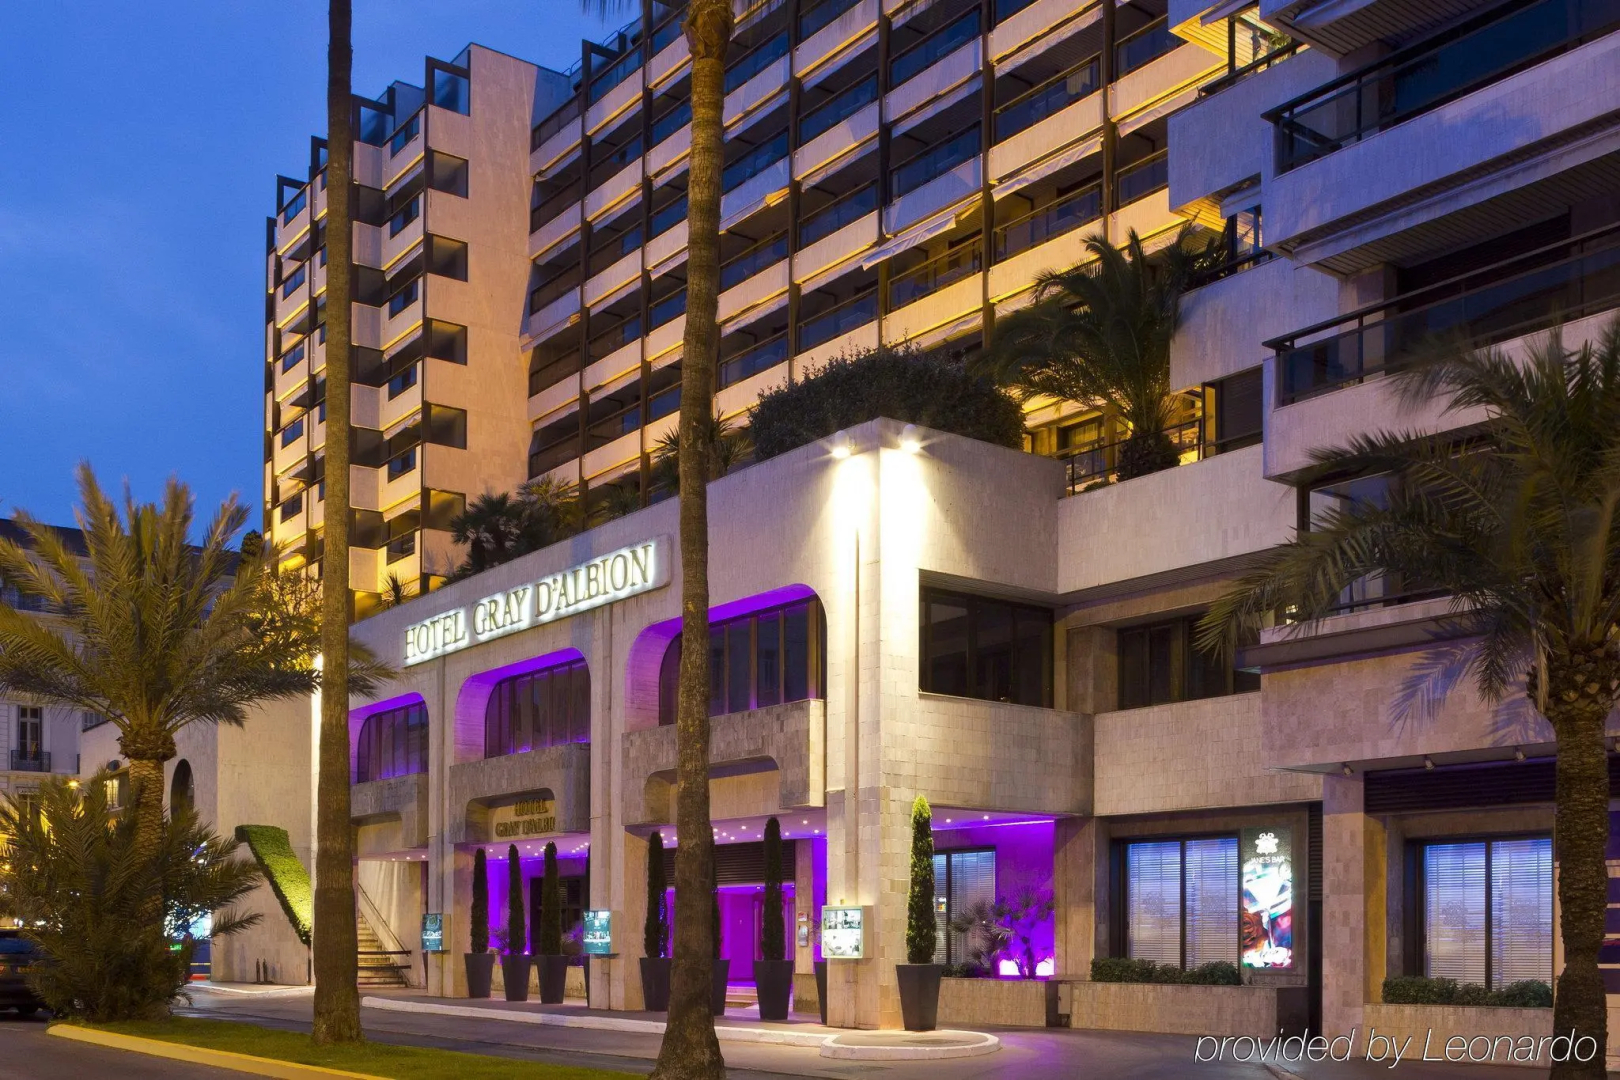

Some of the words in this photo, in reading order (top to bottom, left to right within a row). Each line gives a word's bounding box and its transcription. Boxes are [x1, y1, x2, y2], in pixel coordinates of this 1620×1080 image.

[404, 612, 466, 659] HOTEL
[472, 587, 529, 635] GRAY
[535, 544, 652, 617] D'ALBION
[514, 799, 548, 816] HOTEL
[495, 821, 520, 837] GRAY
